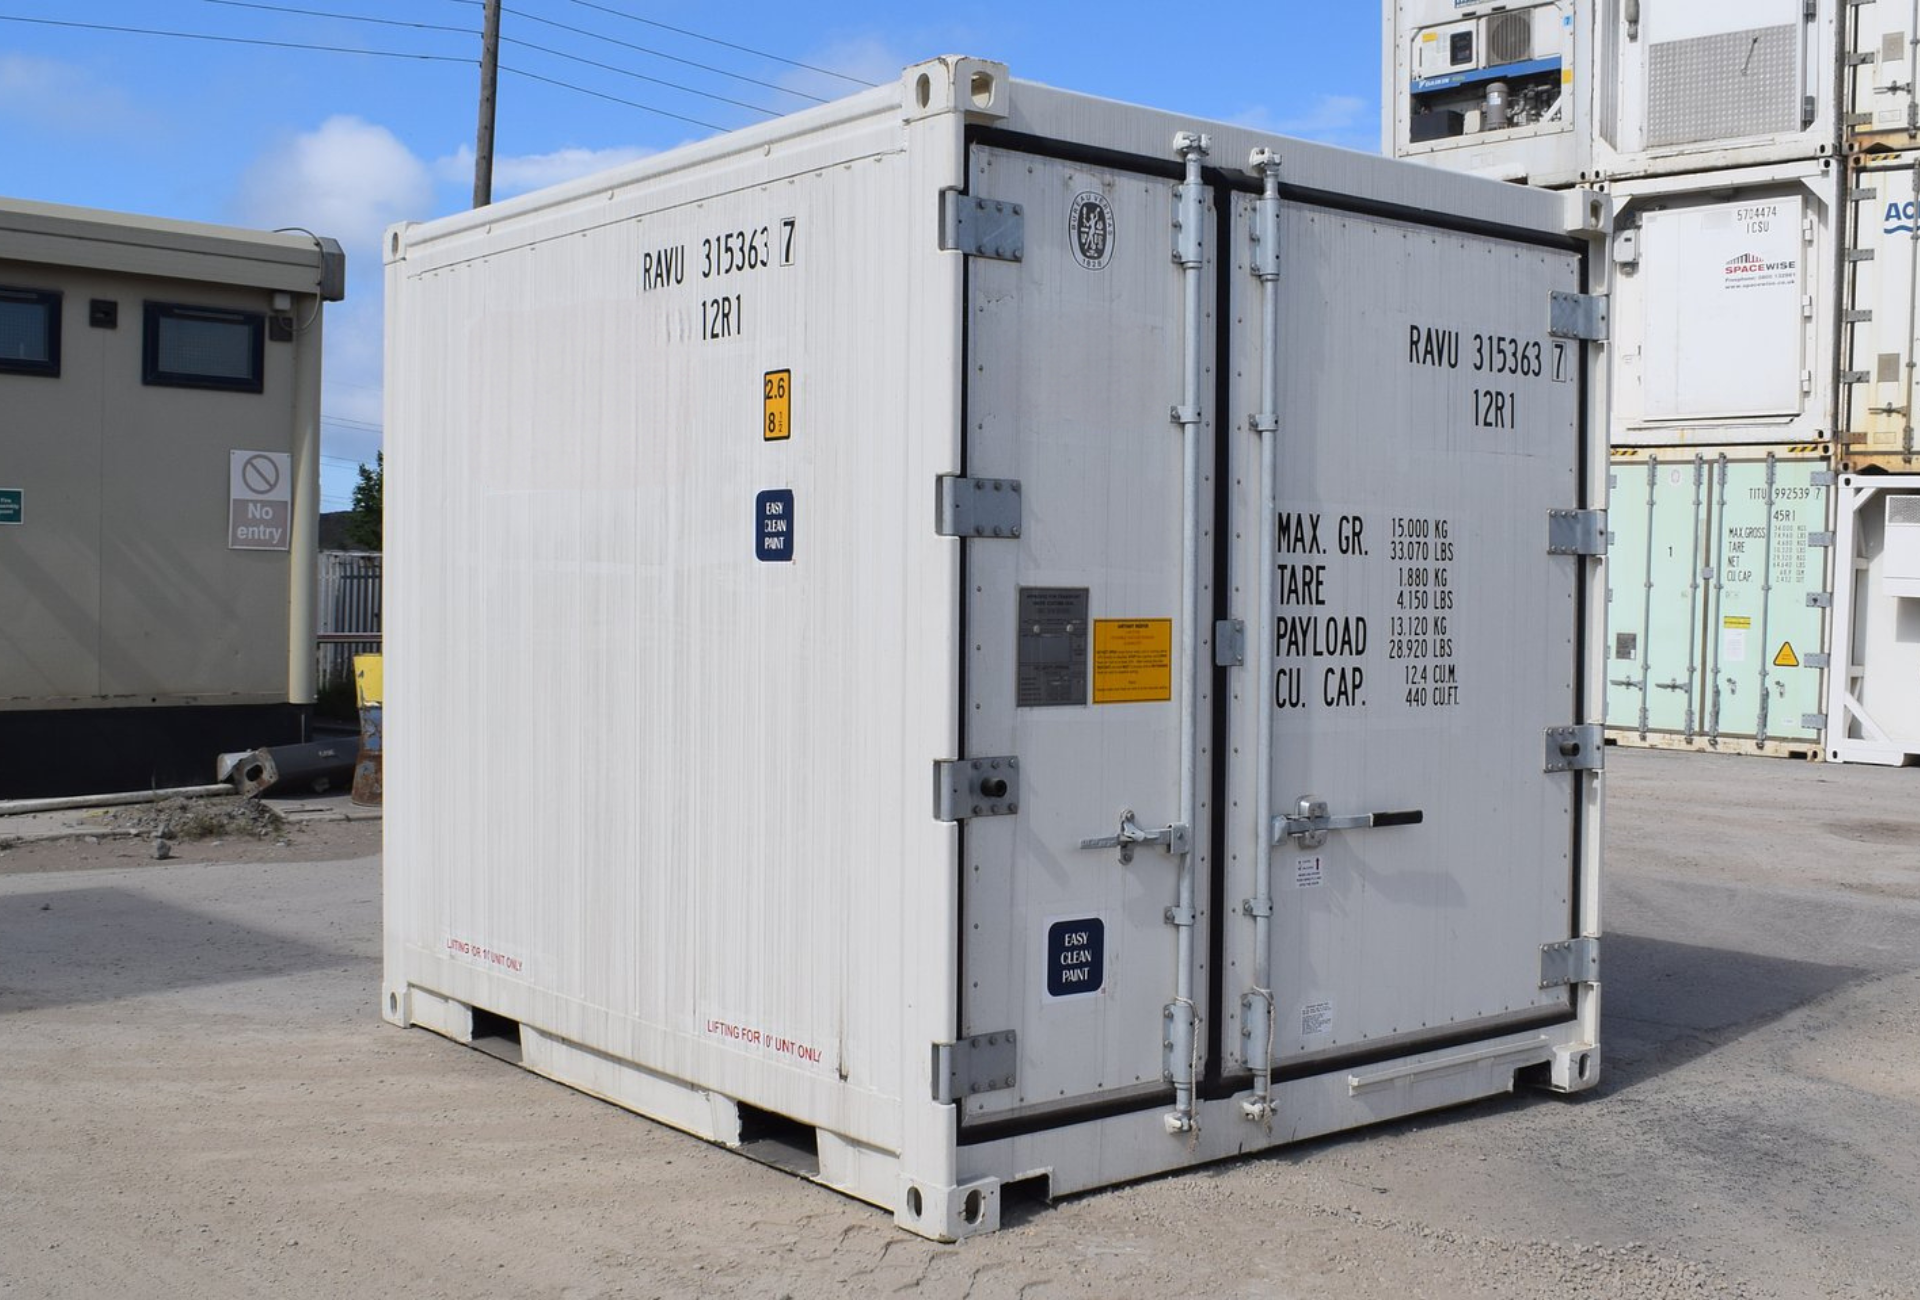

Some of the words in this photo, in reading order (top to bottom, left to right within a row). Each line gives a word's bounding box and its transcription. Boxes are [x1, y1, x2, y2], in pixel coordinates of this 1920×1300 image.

[1737, 205, 1777, 221] 5704474
[1885, 201, 1920, 221] AC
[643, 245, 684, 291] RAVU
[702, 226, 769, 278] 315363
[783, 220, 795, 263] 7
[1725, 261, 1795, 275] SPACEWISE
[702, 293, 741, 340] 12R1
[1409, 324, 1459, 369] RAVU
[1473, 334, 1542, 377] 315363
[1554, 343, 1564, 379] 7
[765, 377, 785, 399] 2.6
[1473, 389, 1515, 429] 12R1
[1749, 487, 1767, 500] TITU
[1774, 487, 1810, 500] 992539
[1814, 488, 1821, 500] 7
[248, 502, 273, 520] No
[766, 501, 784, 516] EASY
[1773, 510, 1796, 522] 45R1
[236, 524, 282, 544] entry
[764, 520, 787, 533] CLEAN
[1277, 512, 1326, 554] MAX.
[1338, 515, 1368, 555] GR.
[1392, 518, 1429, 539] 15.000
[1434, 519, 1448, 539] KG
[764, 536, 785, 550] PAINT
[1390, 541, 1429, 561] 33.070
[1434, 542, 1454, 561] LBS
[1668, 546, 1673, 557] 1
[1728, 541, 1745, 553] TARE
[1727, 555, 1740, 568] NET
[1277, 564, 1326, 605] TARE
[1399, 567, 1428, 587] 1.880
[1434, 568, 1447, 587] KG
[1397, 590, 1428, 610] 4.150
[1434, 591, 1454, 610] LBS
[1275, 616, 1367, 657] PAYLOAD
[1390, 616, 1428, 636] 13.120
[1433, 616, 1447, 636] KG
[1389, 639, 1428, 659] 28.920
[1433, 639, 1453, 658] LBS
[1275, 667, 1306, 709] CU.
[1323, 666, 1366, 707] CAP.
[1405, 664, 1427, 685] 12.4
[1405, 687, 1427, 707] 440
[1065, 931, 1089, 947] EASY
[1060, 949, 1092, 965] CLEAN
[1062, 967, 1090, 983] PAINT
[707, 1019, 740, 1039] LIFTING
[741, 1028, 761, 1044] FOR
